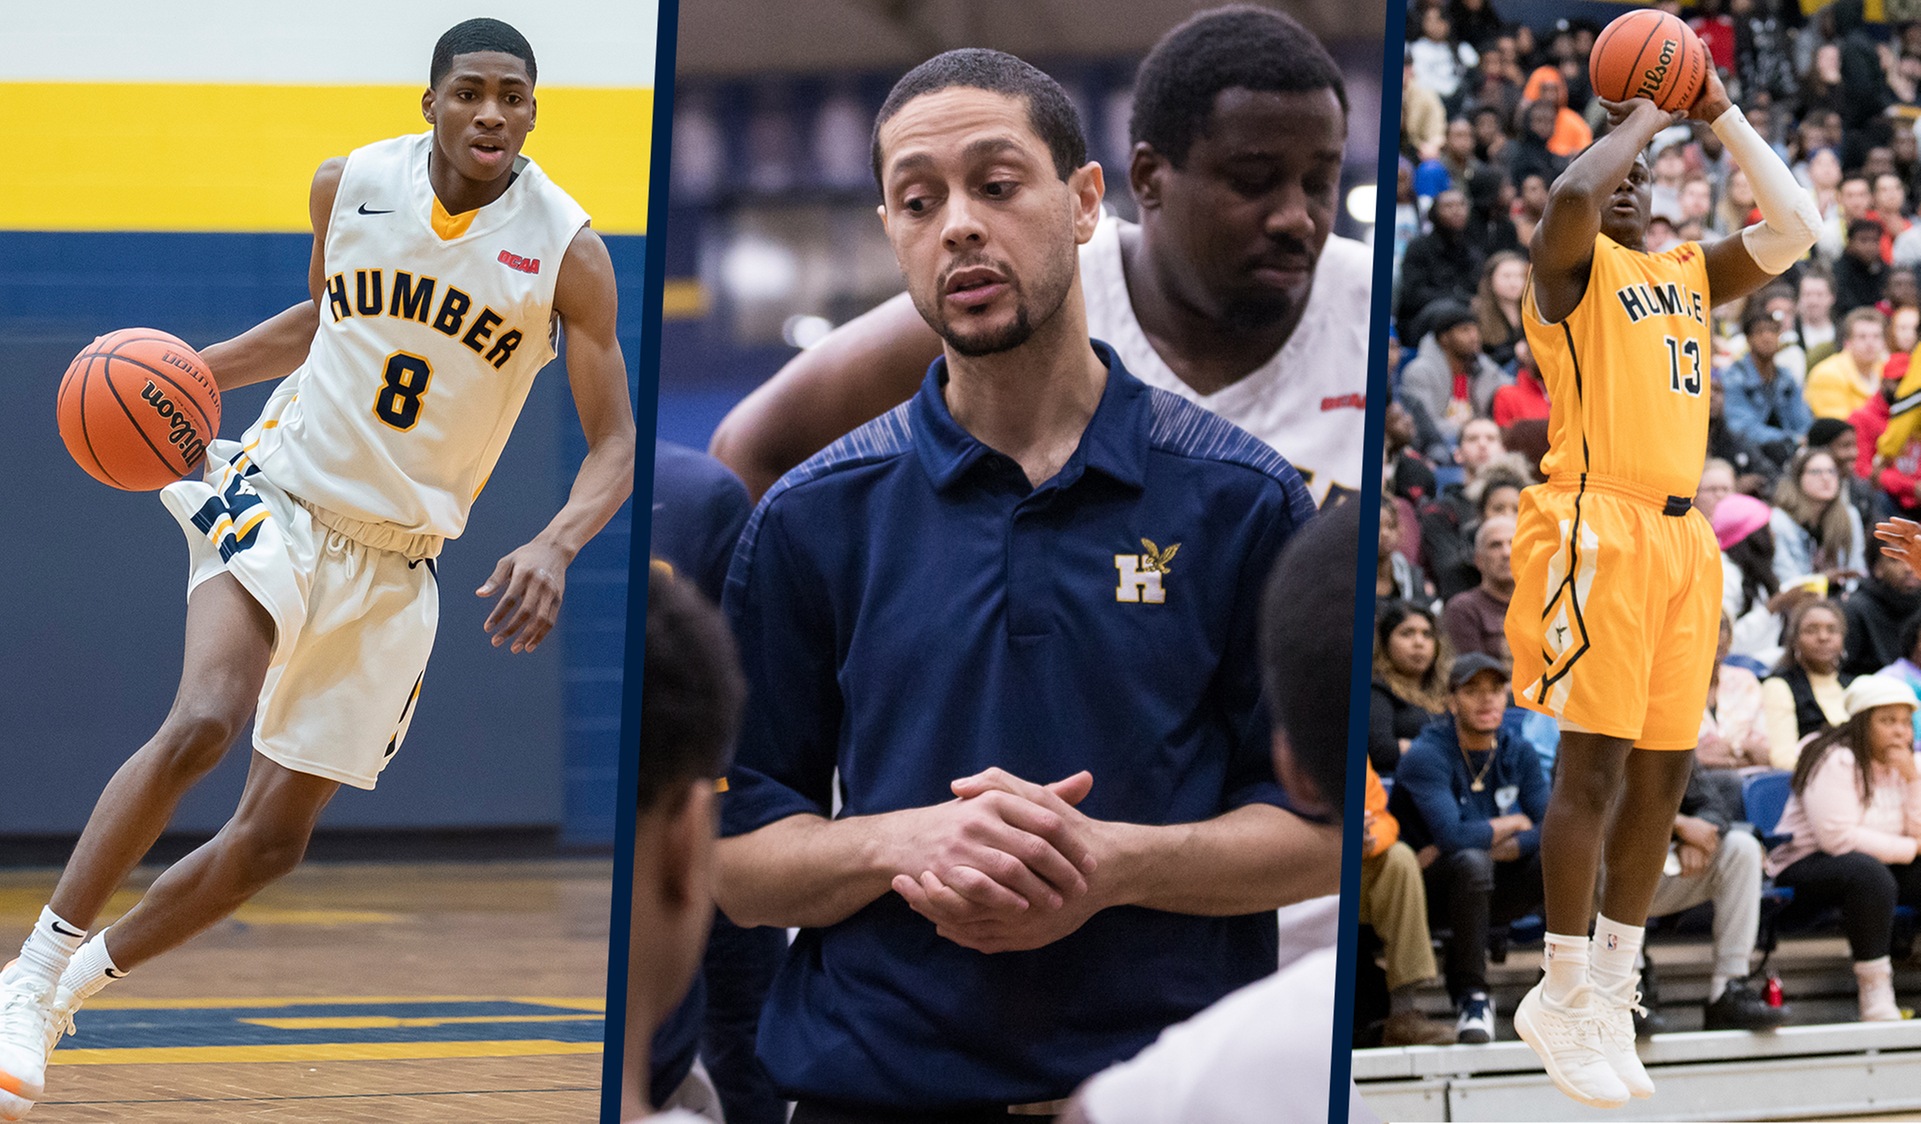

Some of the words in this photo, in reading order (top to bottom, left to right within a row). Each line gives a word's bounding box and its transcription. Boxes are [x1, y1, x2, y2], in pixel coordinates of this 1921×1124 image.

[497, 249, 541, 275] OCAA
[325, 268, 524, 372] HUMBER
[1617, 281, 1708, 328] HUME
[161, 353, 220, 416] VOLUTION
[372, 349, 434, 433] 8
[1663, 334, 1702, 398] 13
[140, 379, 207, 469] Wilson
[1114, 554, 1166, 604] H
